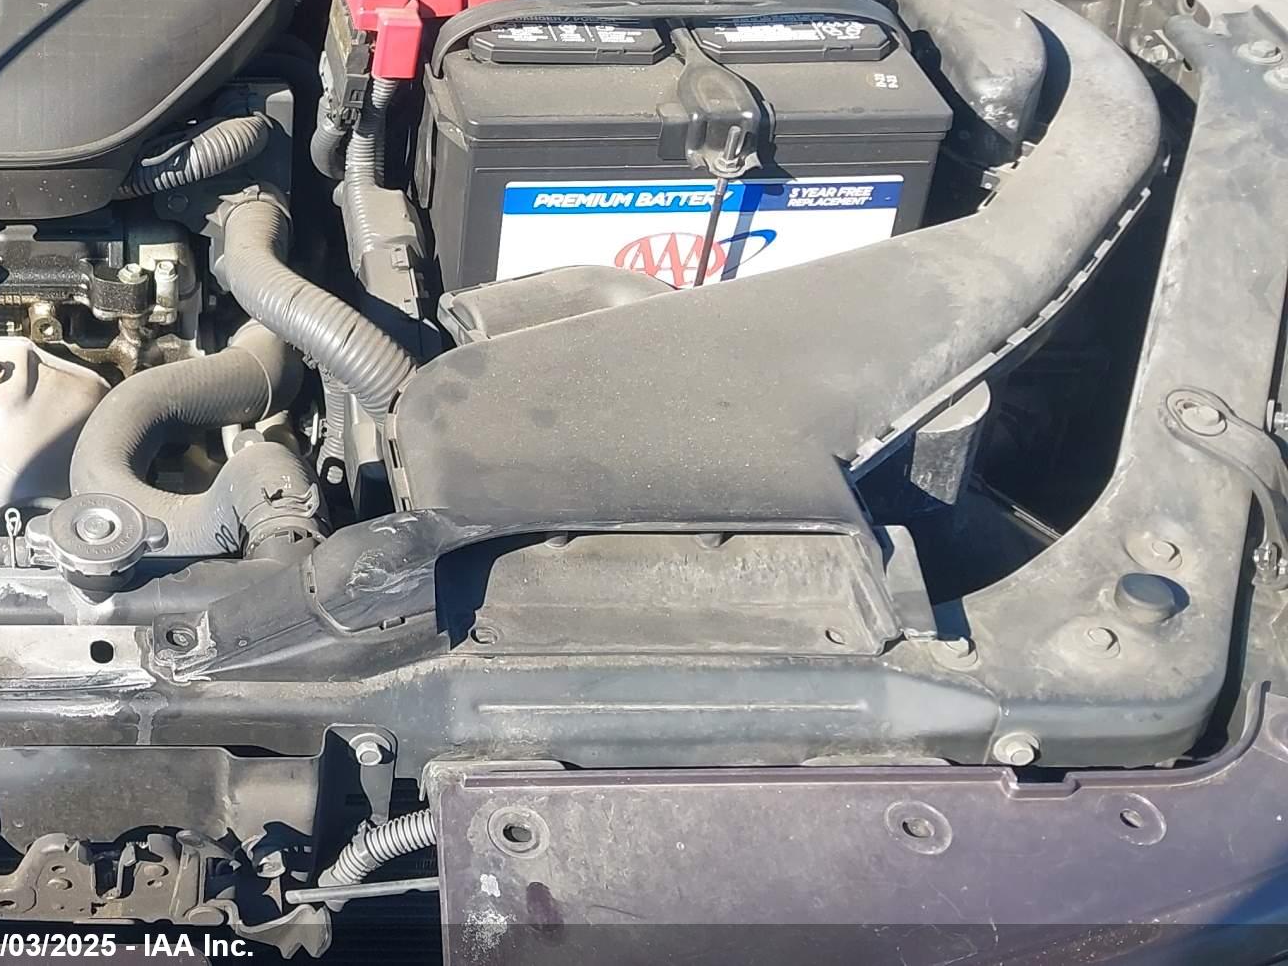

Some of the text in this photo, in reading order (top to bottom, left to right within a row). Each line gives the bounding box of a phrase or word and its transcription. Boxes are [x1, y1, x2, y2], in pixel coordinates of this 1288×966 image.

[533, 192, 635, 208] PREMIUM
[802, 187, 838, 198] YEAR
[837, 186, 874, 197] FREE
[614, 232, 727, 288] AAA
